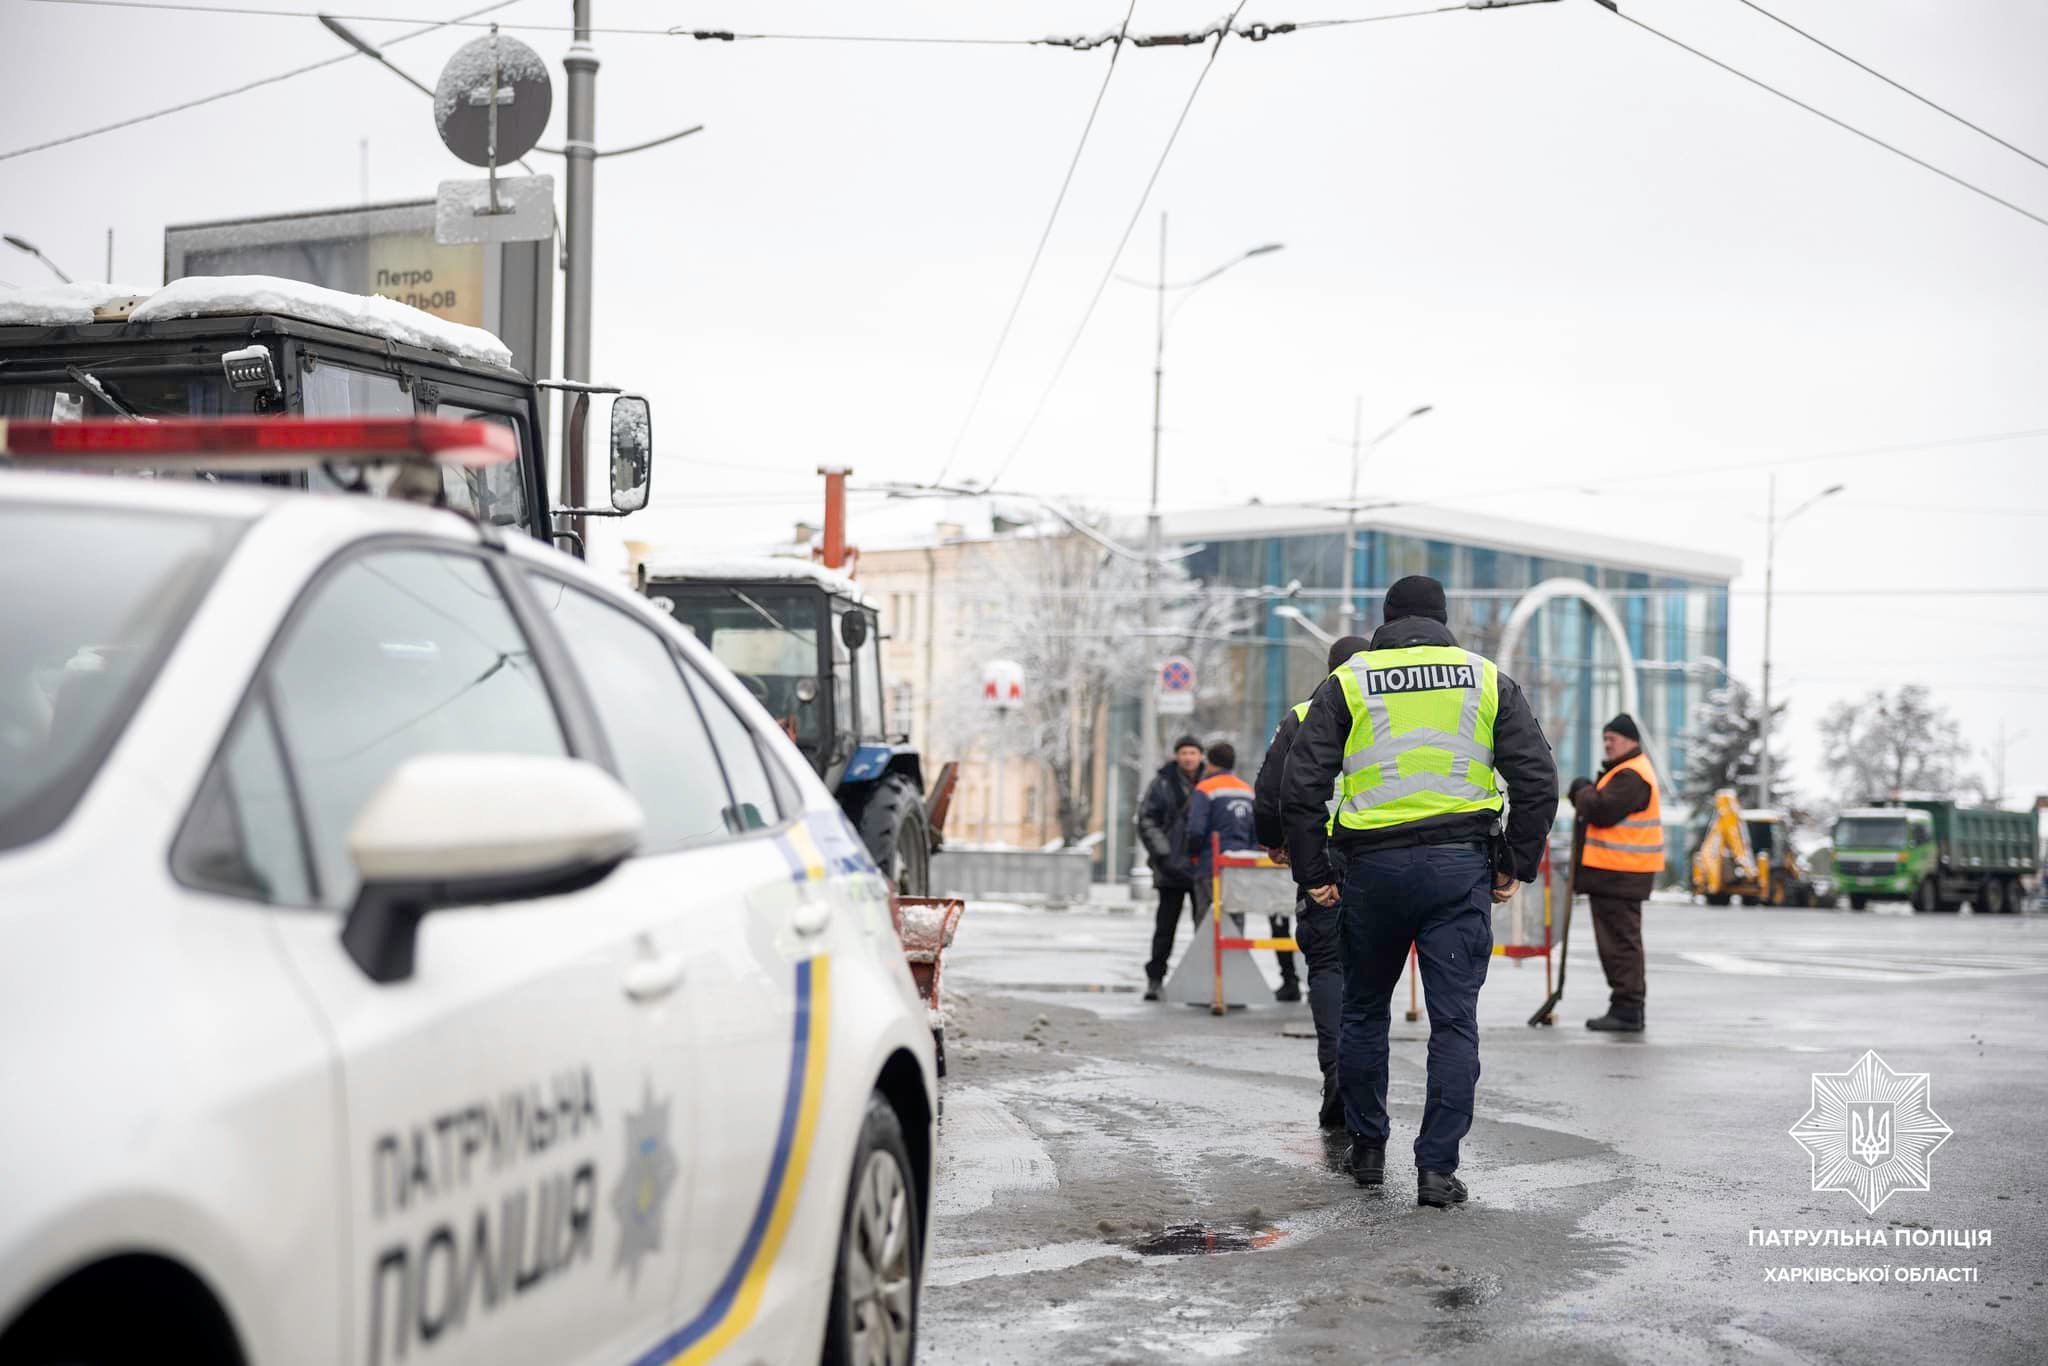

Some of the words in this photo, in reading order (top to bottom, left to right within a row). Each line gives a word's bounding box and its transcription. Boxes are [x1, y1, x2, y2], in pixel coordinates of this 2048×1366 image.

[377, 269, 433, 288] Петро
[1368, 665, 1474, 692] ПОЛІЦІЯ
[367, 1158, 597, 1366] ПОЛІЦІЯ
